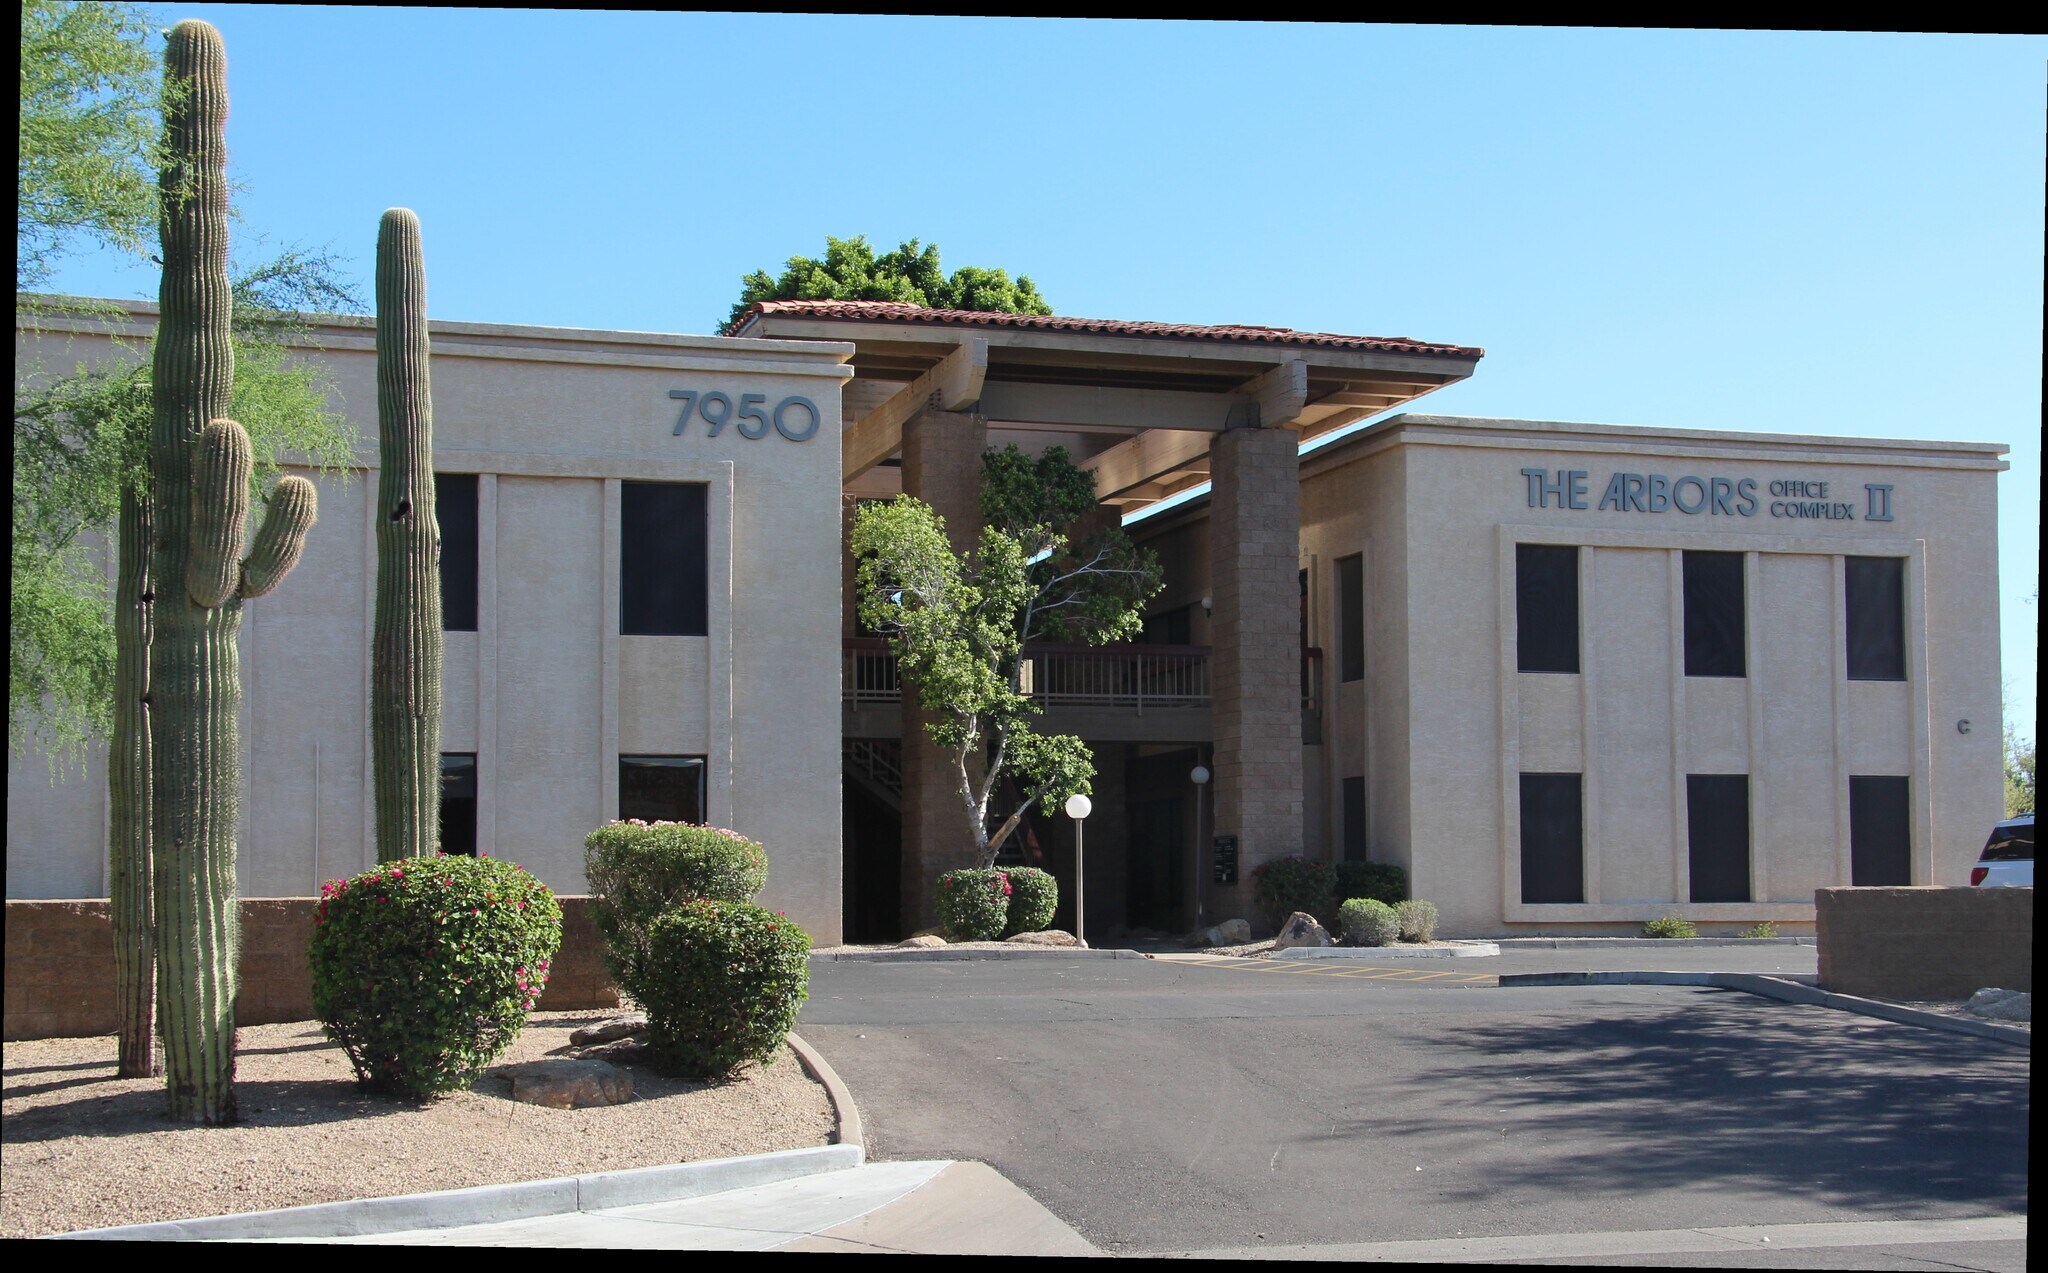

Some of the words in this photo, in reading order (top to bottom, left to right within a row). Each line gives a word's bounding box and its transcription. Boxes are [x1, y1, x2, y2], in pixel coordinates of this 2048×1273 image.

[669, 389, 821, 442] 7950
[1521, 468, 1589, 510] THE
[1599, 472, 1759, 517] ARBORS
[1769, 479, 1829, 500] OFFICE
[1864, 483, 1894, 522] II
[1770, 501, 1855, 521] COMPLEX
[1957, 718, 1971, 735] C
